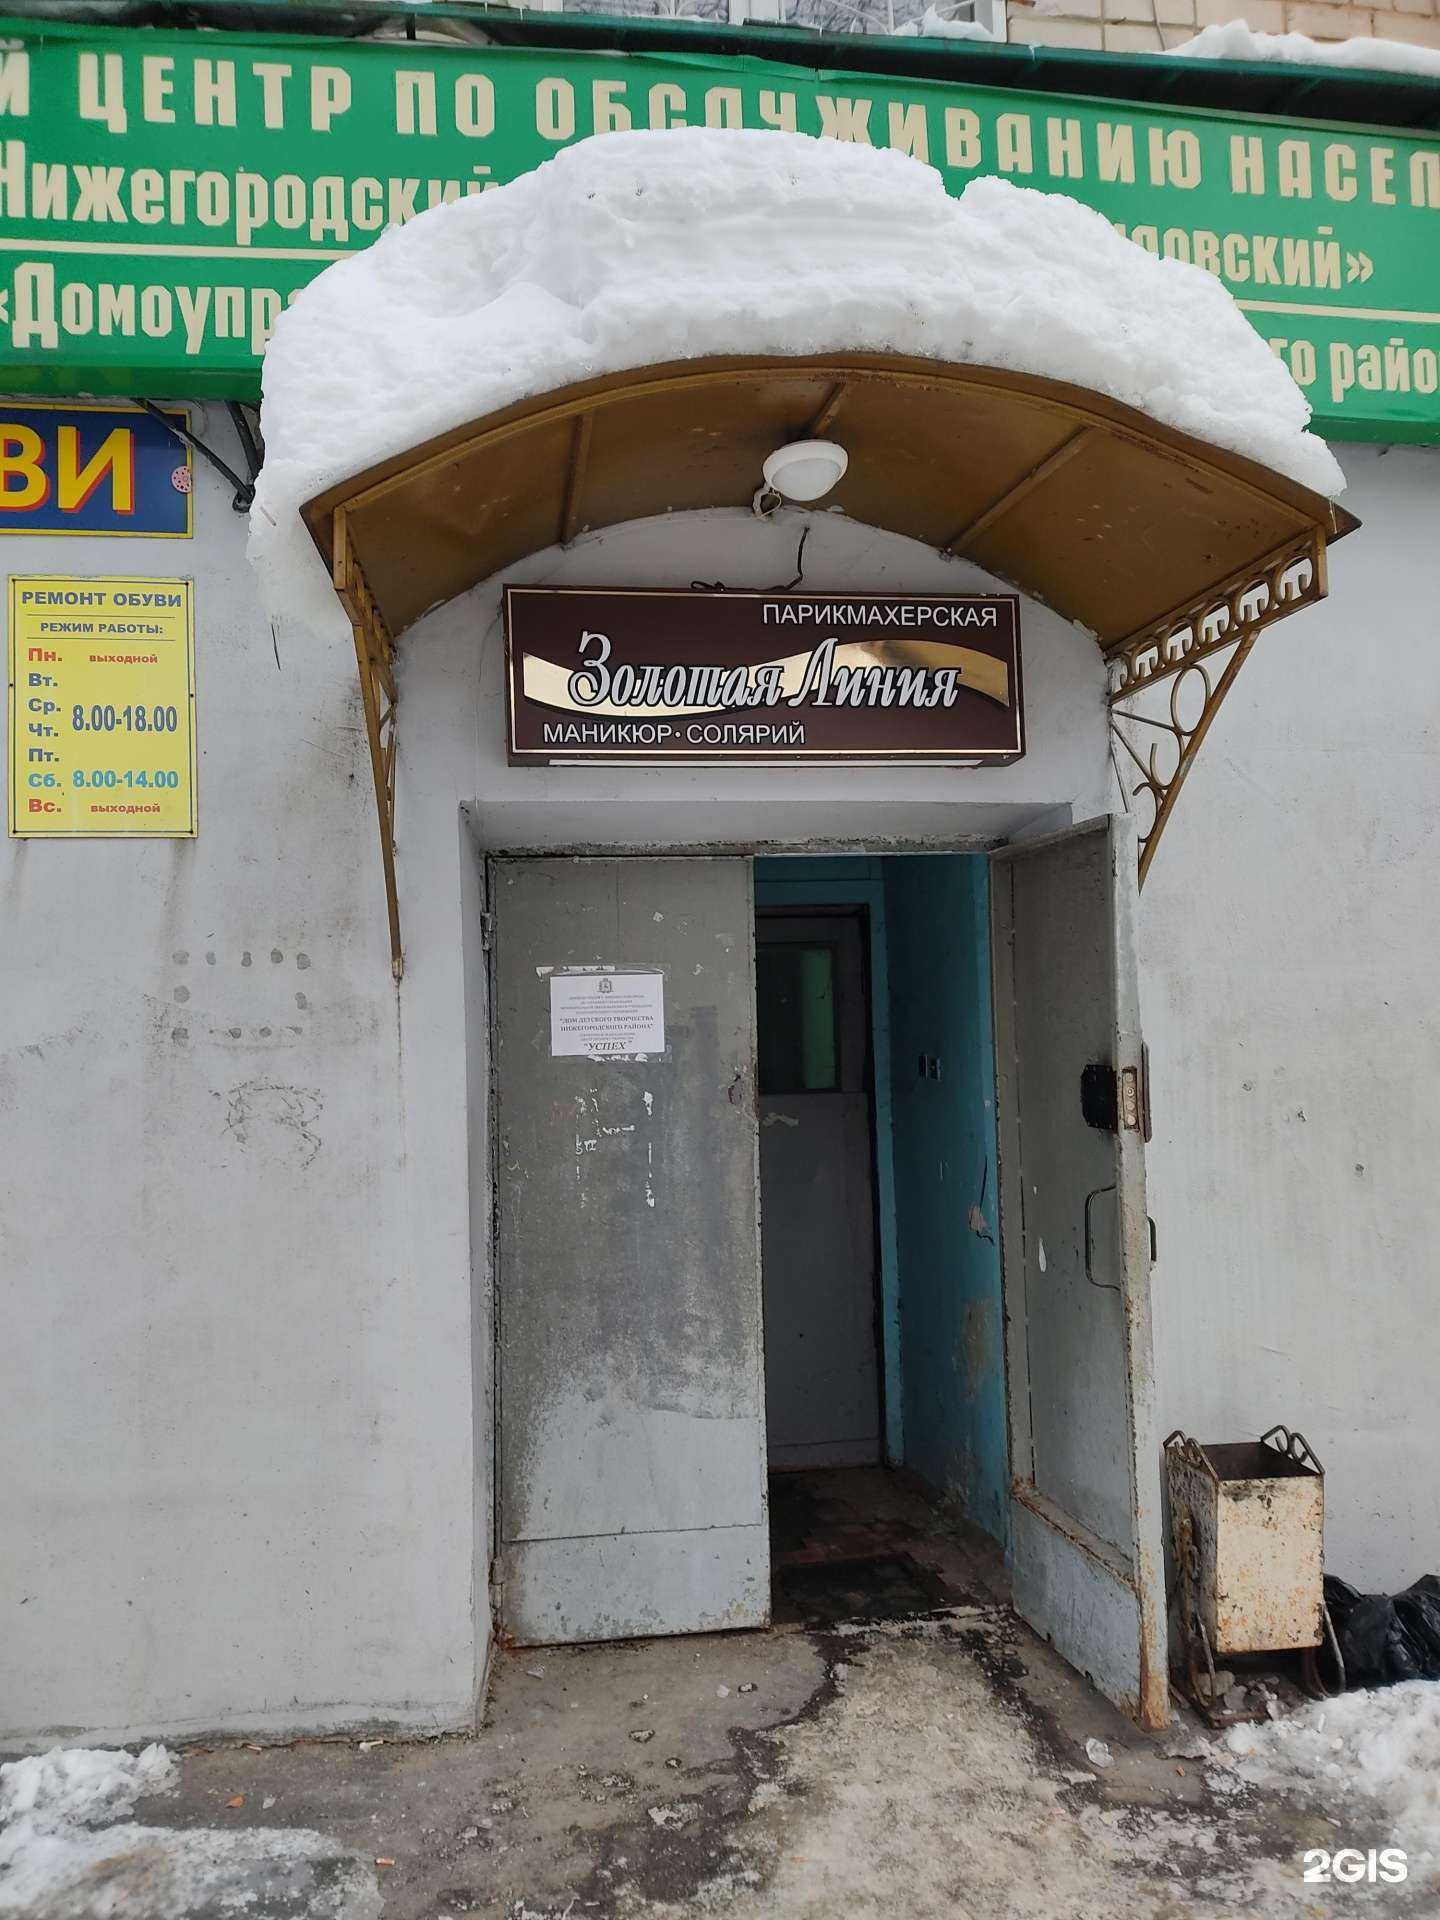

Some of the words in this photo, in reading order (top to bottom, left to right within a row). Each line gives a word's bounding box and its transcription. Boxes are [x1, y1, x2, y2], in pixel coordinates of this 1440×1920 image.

[79, 53, 352, 133] ЦЕНТР
[395, 70, 496, 138] ПО
[1231, 135, 1440, 209] НАСЕЛ
[22, 591, 106, 605] РЕМОНТ
[113, 593, 182, 607] ОБУВИ
[763, 604, 998, 627] ПАРИКМАХЕРСКАЯ
[40, 622, 94, 633] РЕЖИМ
[98, 623, 164, 634] РАБОТЫ:
[28, 648, 63, 662] Пн.
[89, 654, 158, 664] выходной
[568, 630, 783, 707] Золотая
[793, 637, 962, 708] Линия
[28, 673, 58, 687] Вт.
[28, 698, 62, 715] Ср.
[72, 705, 178, 732] 8.00-18.00
[28, 724, 59, 737] Чт.
[28, 749, 60, 762] Пт.
[28, 774, 62, 788] Сб.
[72, 770, 179, 788] 8.00-14.00
[28, 799, 62, 813] Вс.
[90, 803, 161, 814] выходной
